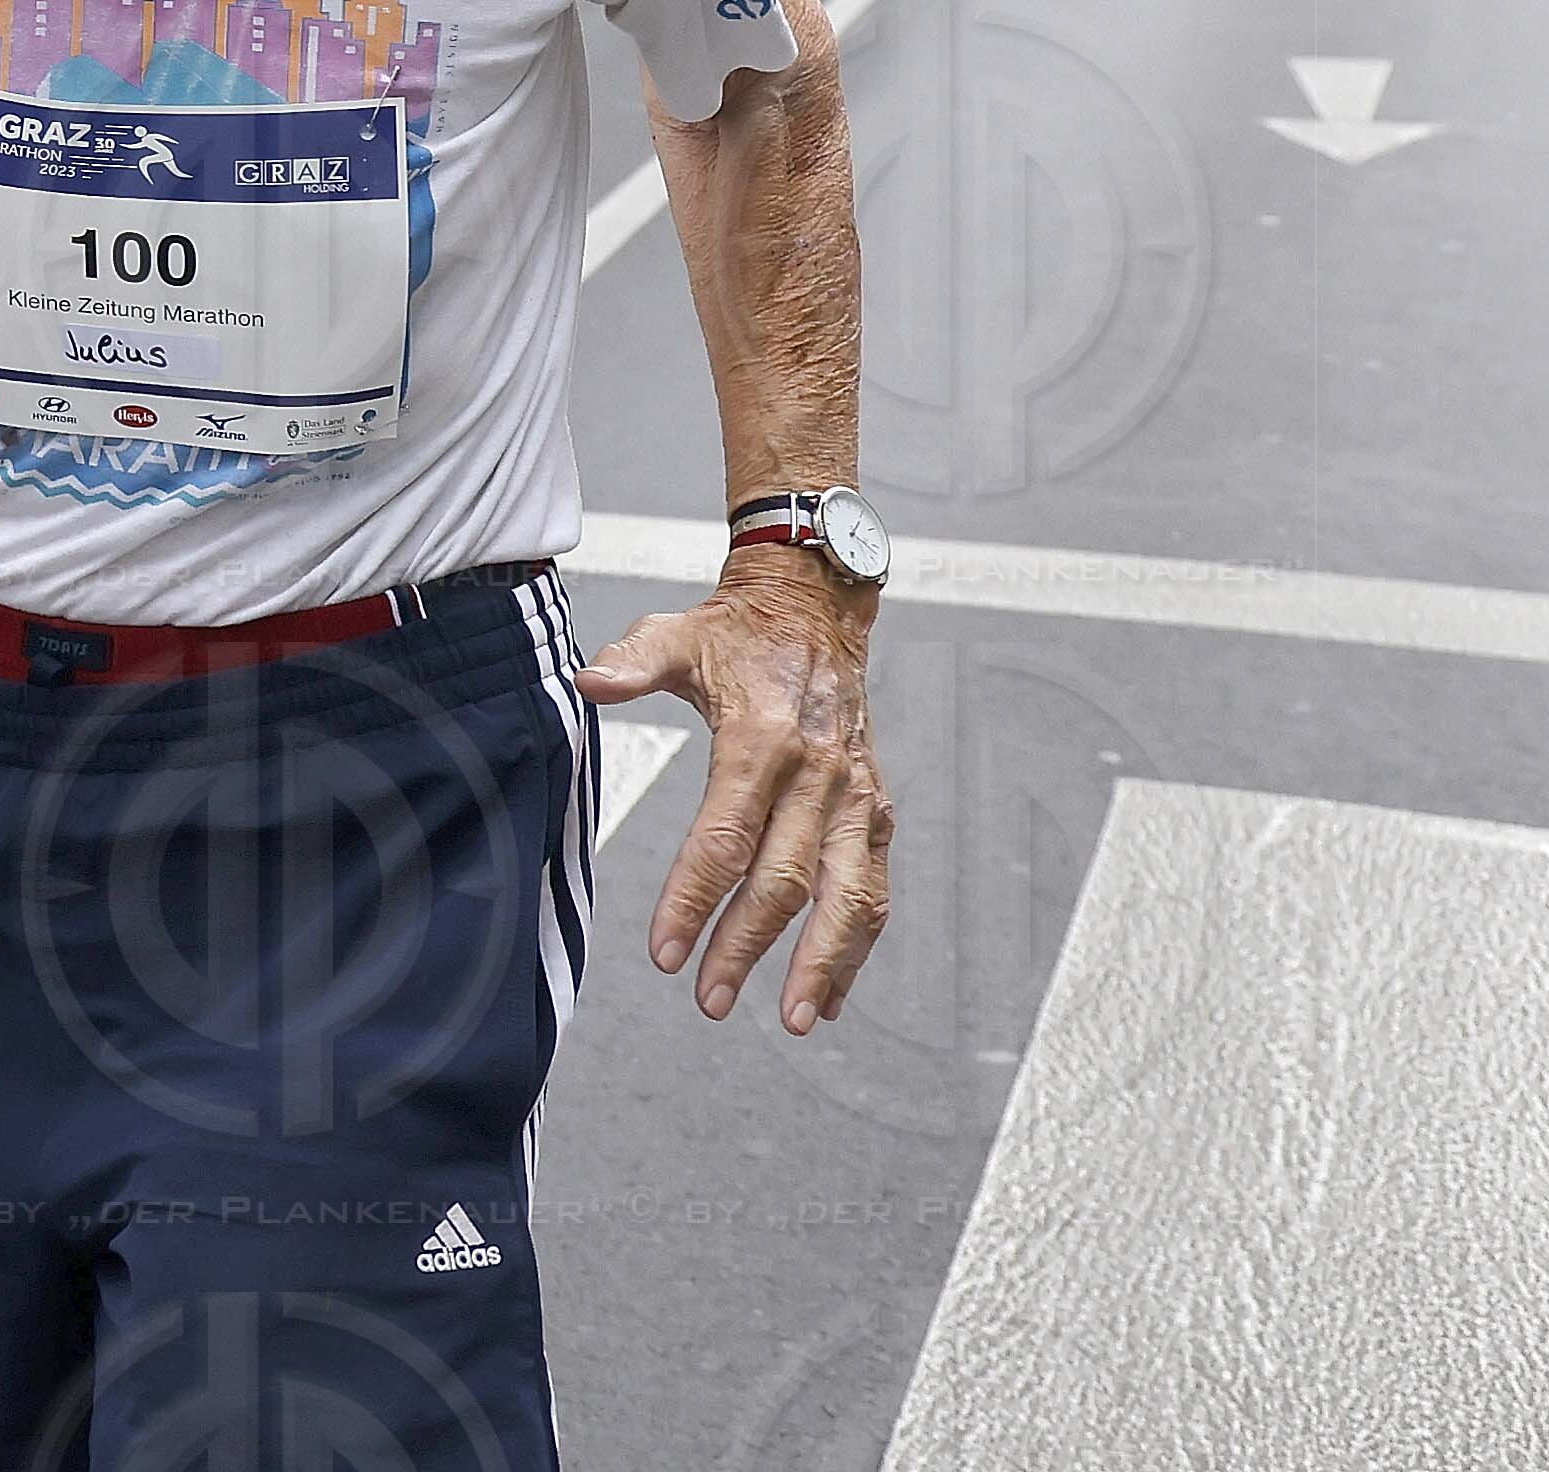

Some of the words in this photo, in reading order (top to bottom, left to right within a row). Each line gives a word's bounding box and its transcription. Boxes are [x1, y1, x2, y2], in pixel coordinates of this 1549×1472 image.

[94, 137, 115, 150] 30
[38, 163, 77, 178] 2023
[237, 159, 346, 184] GRAZ
[303, 182, 350, 194] HOLDING
[70, 228, 198, 287] 100
[7, 289, 72, 313] Kleine
[77, 296, 156, 324] Zeitung
[162, 304, 265, 328] Marathon
[64, 328, 169, 369] Julius
[32, 412, 78, 425] HYUNDAI
[416, 1244, 502, 1273] adidas
